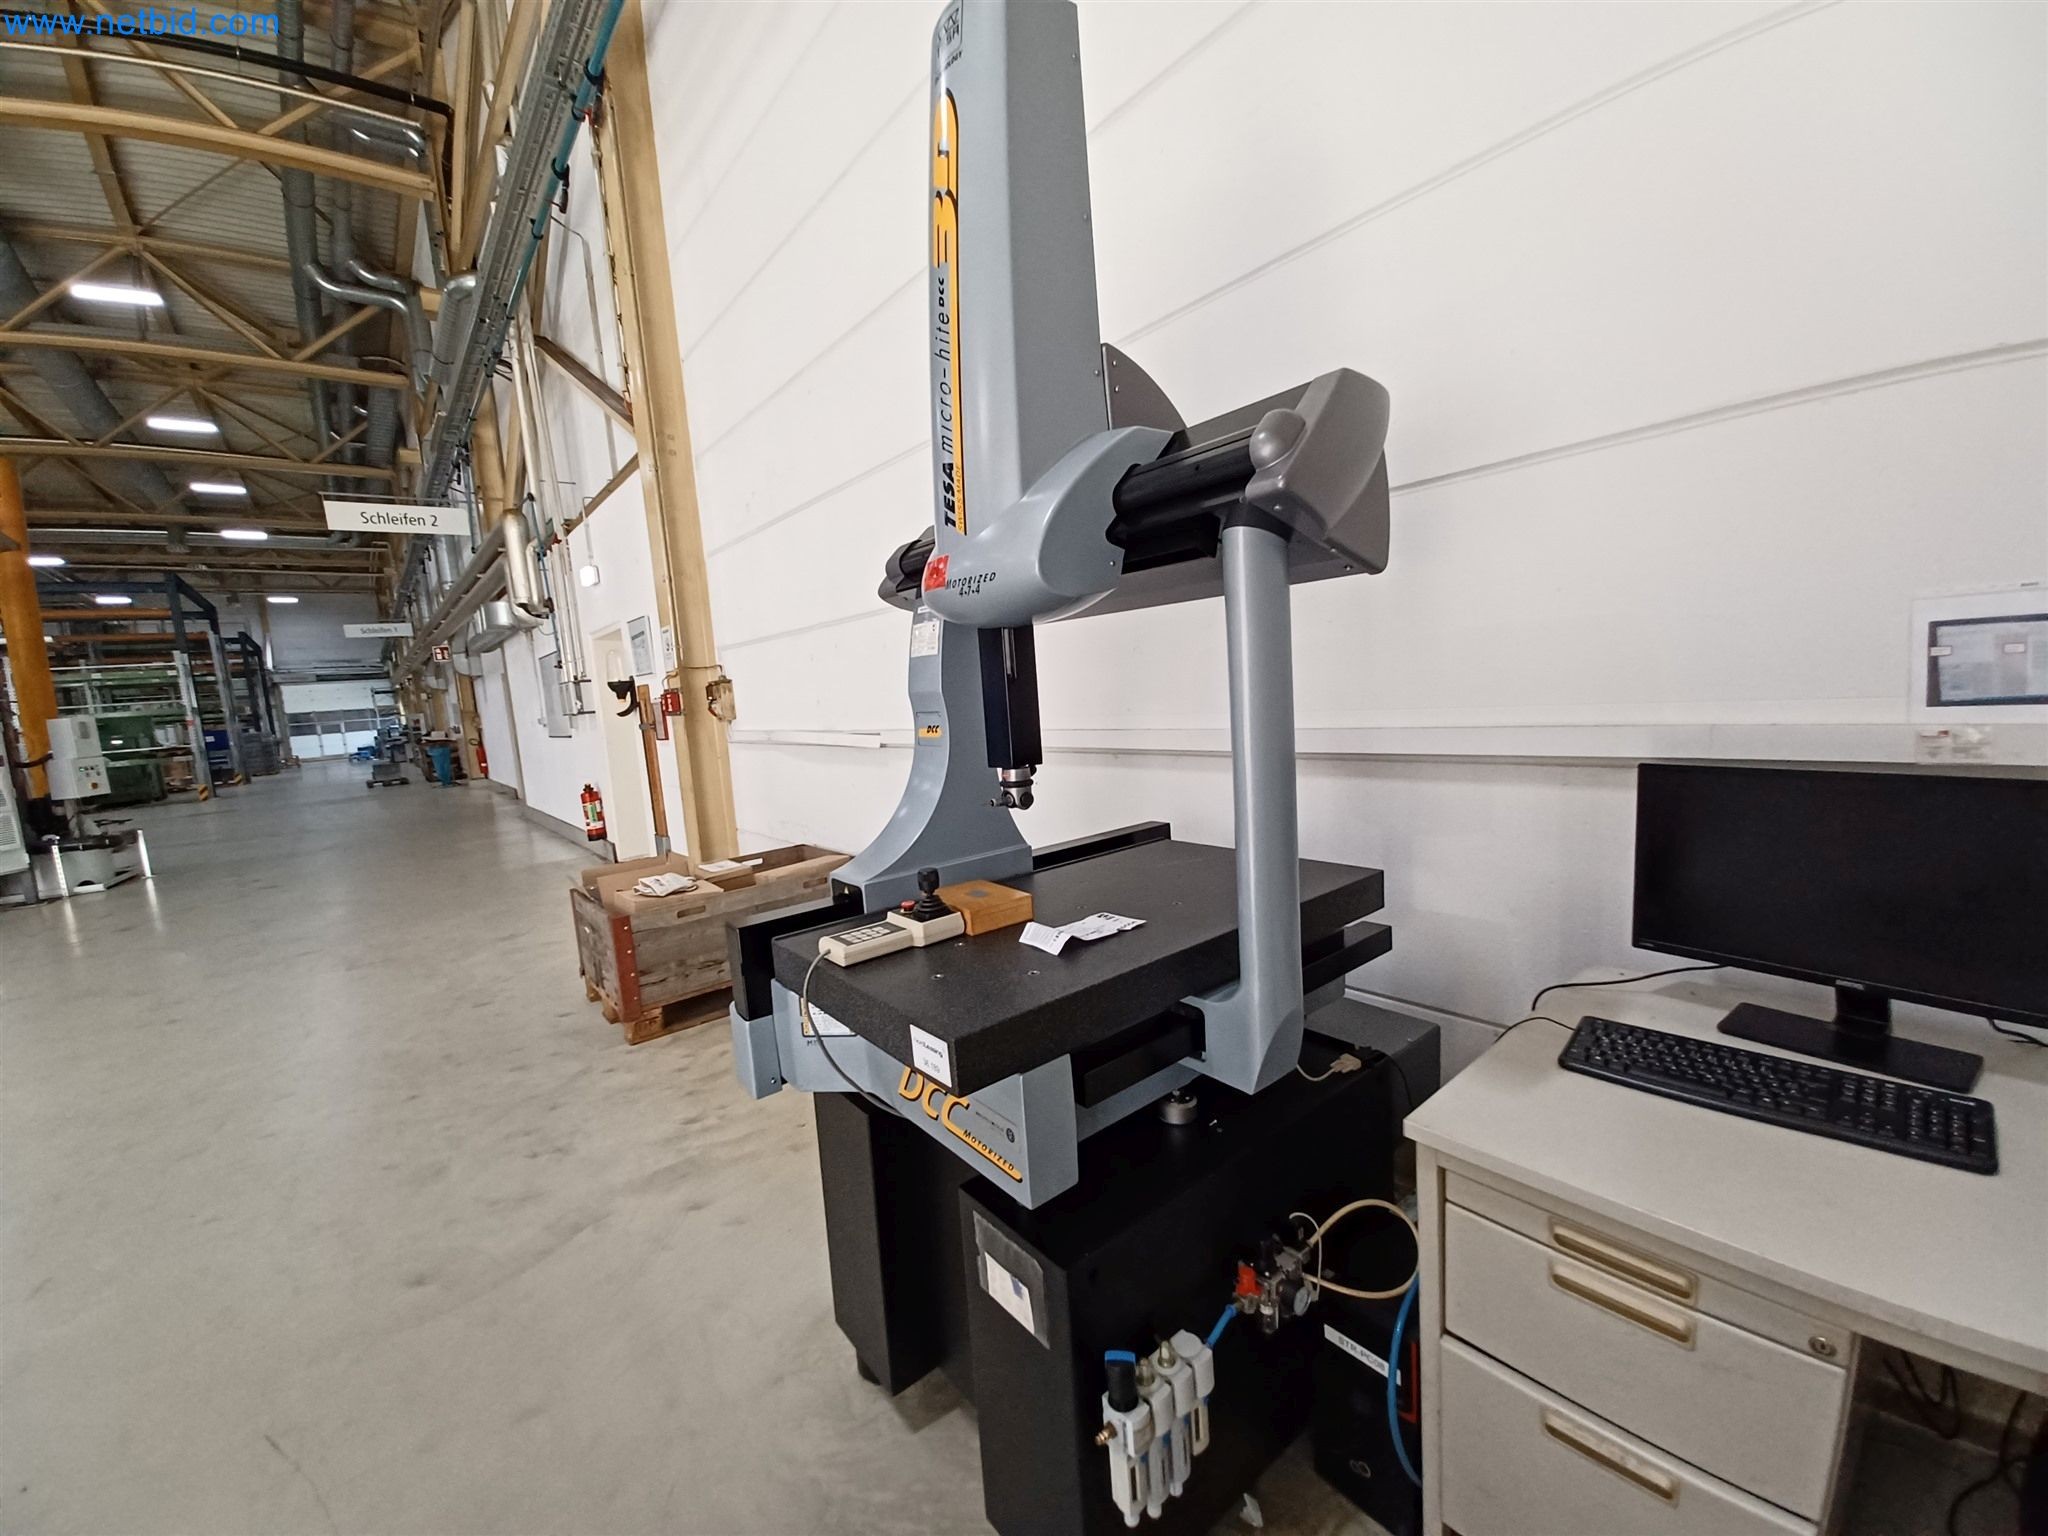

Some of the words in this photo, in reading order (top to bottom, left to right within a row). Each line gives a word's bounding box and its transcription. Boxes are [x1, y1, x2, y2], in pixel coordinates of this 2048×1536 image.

[935, 312, 954, 457] micro-hite
[360, 511, 426, 526] Schleifen
[430, 514, 439, 527] 2
[943, 463, 956, 528] TESA
[898, 1066, 970, 1129] DCC
[963, 1129, 1015, 1172] MOTORIZED
